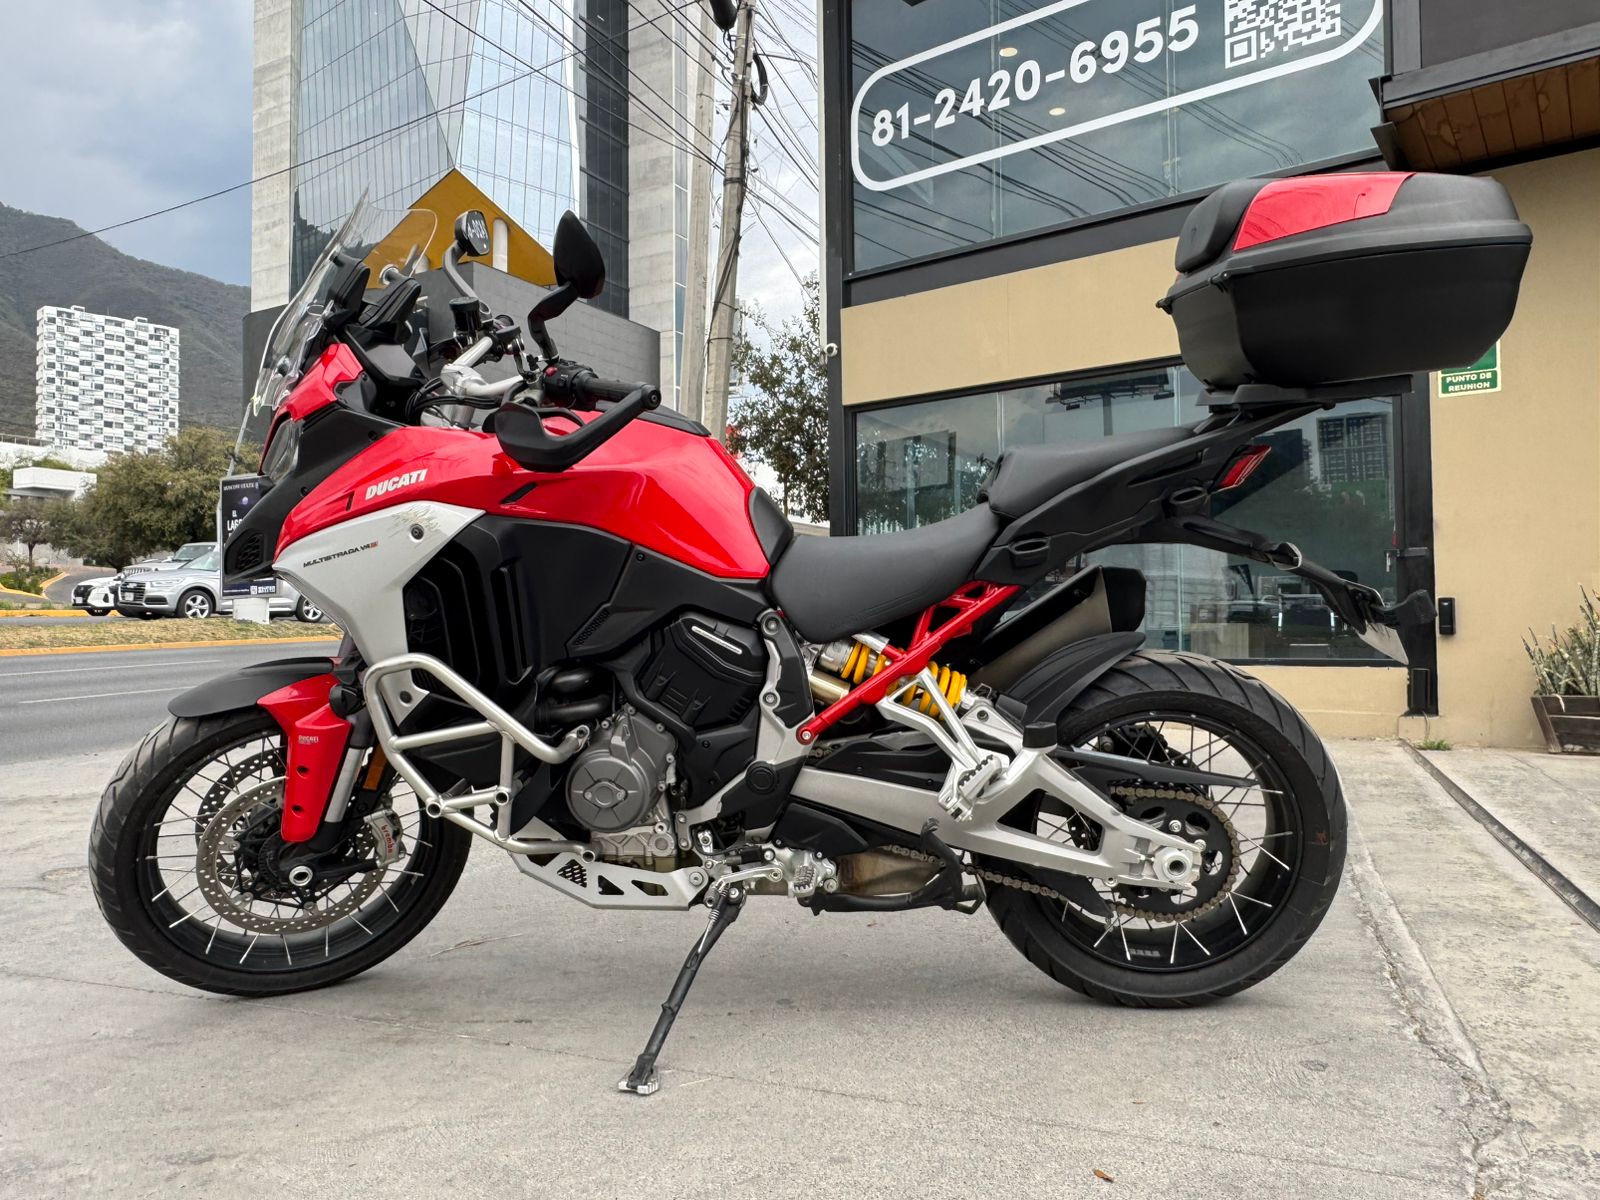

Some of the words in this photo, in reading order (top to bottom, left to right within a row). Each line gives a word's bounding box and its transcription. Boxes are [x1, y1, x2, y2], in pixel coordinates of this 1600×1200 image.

[871, 4, 1199, 148] 81-2420-6955
[1446, 373, 1477, 384] PUNTO
[1480, 371, 1492, 380] DE
[1448, 381, 1491, 392] REUNION
[365, 468, 428, 501] DUCATI
[303, 547, 360, 568] MULTISTRADA
[381, 824, 395, 854] brembo
